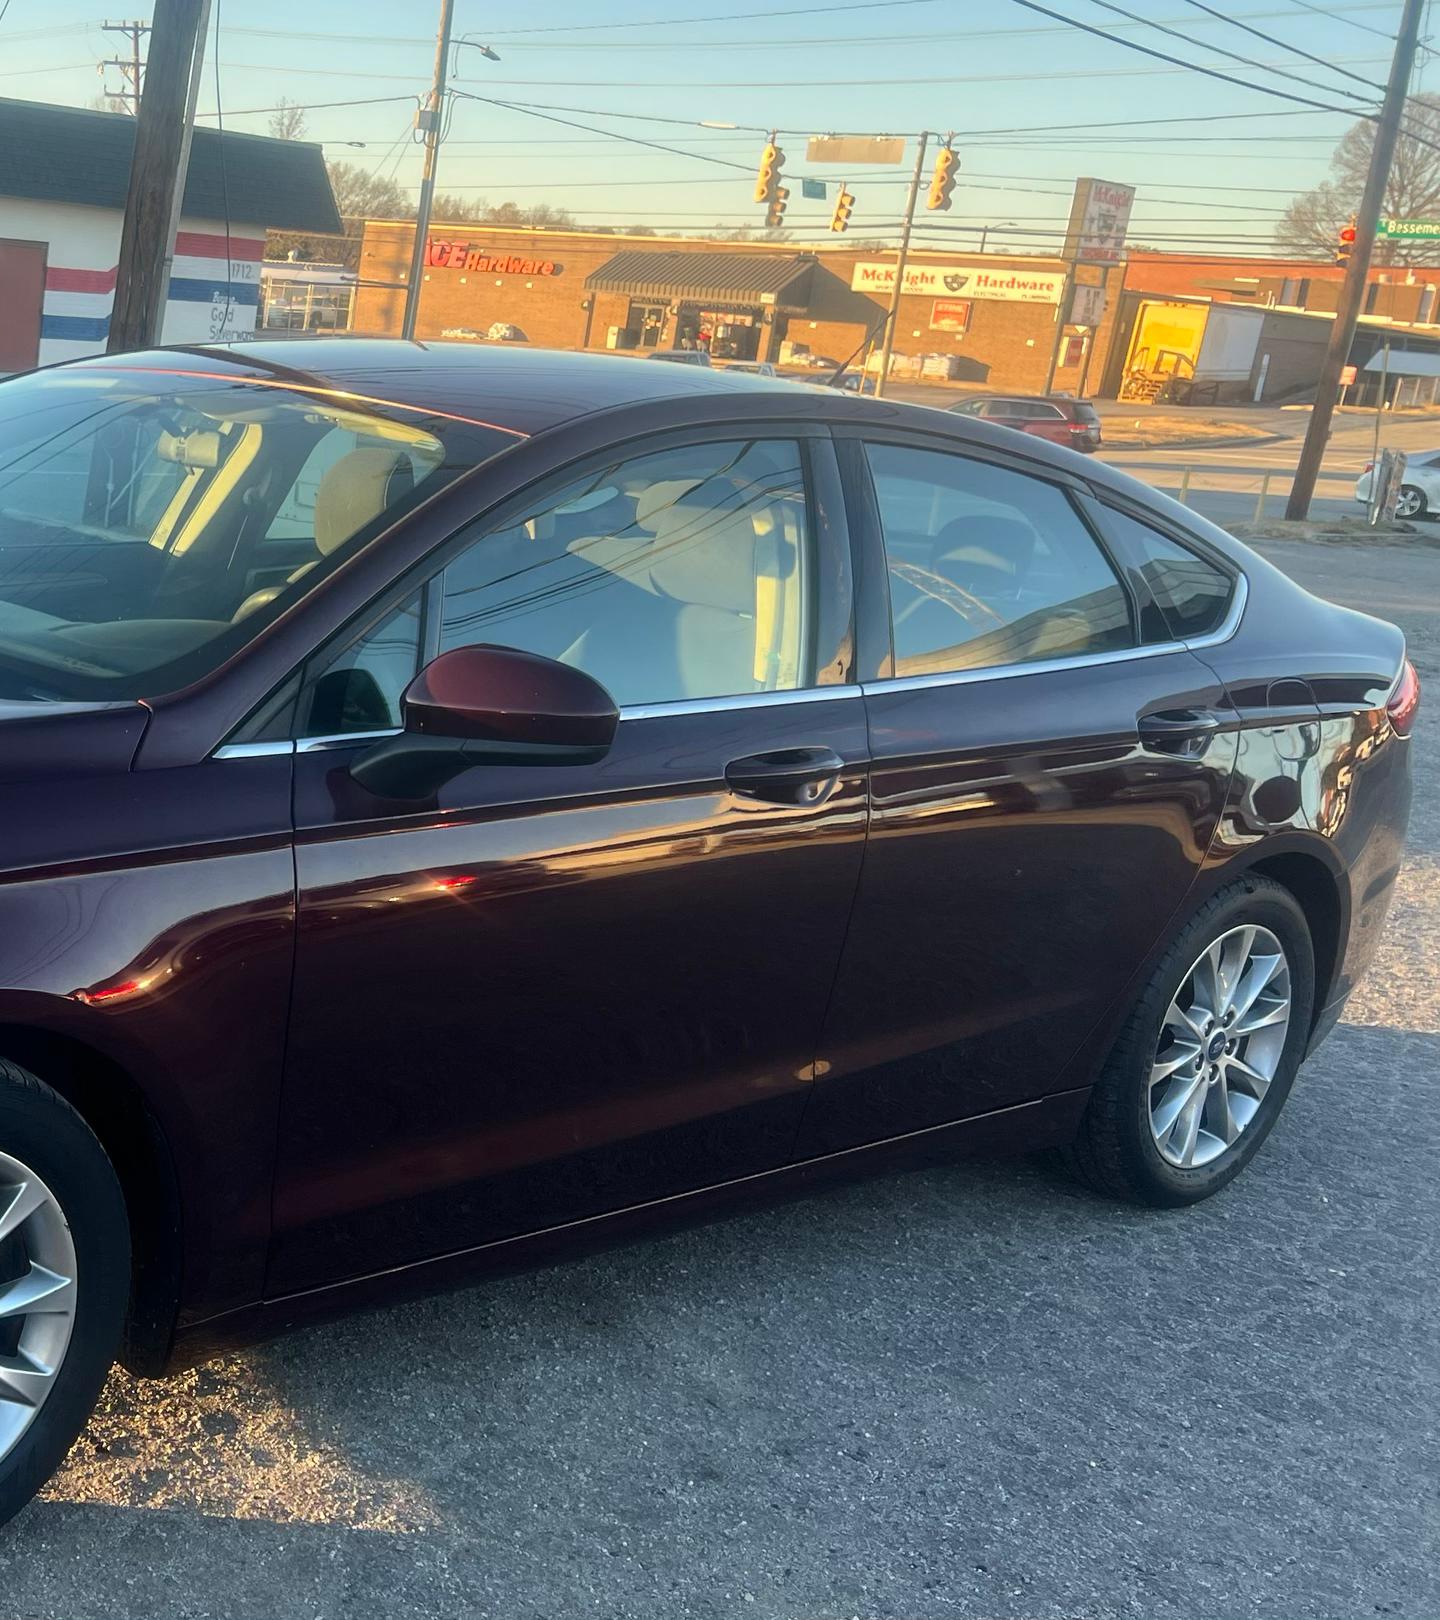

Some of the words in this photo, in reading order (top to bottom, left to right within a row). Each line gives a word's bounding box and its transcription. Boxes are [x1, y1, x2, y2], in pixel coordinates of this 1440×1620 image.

[464, 251, 555, 276] Hardware
[862, 268, 936, 287] McKight
[976, 274, 1055, 292] Hardware
[211, 307, 235, 322] God
[209, 325, 255, 341] Siverware
